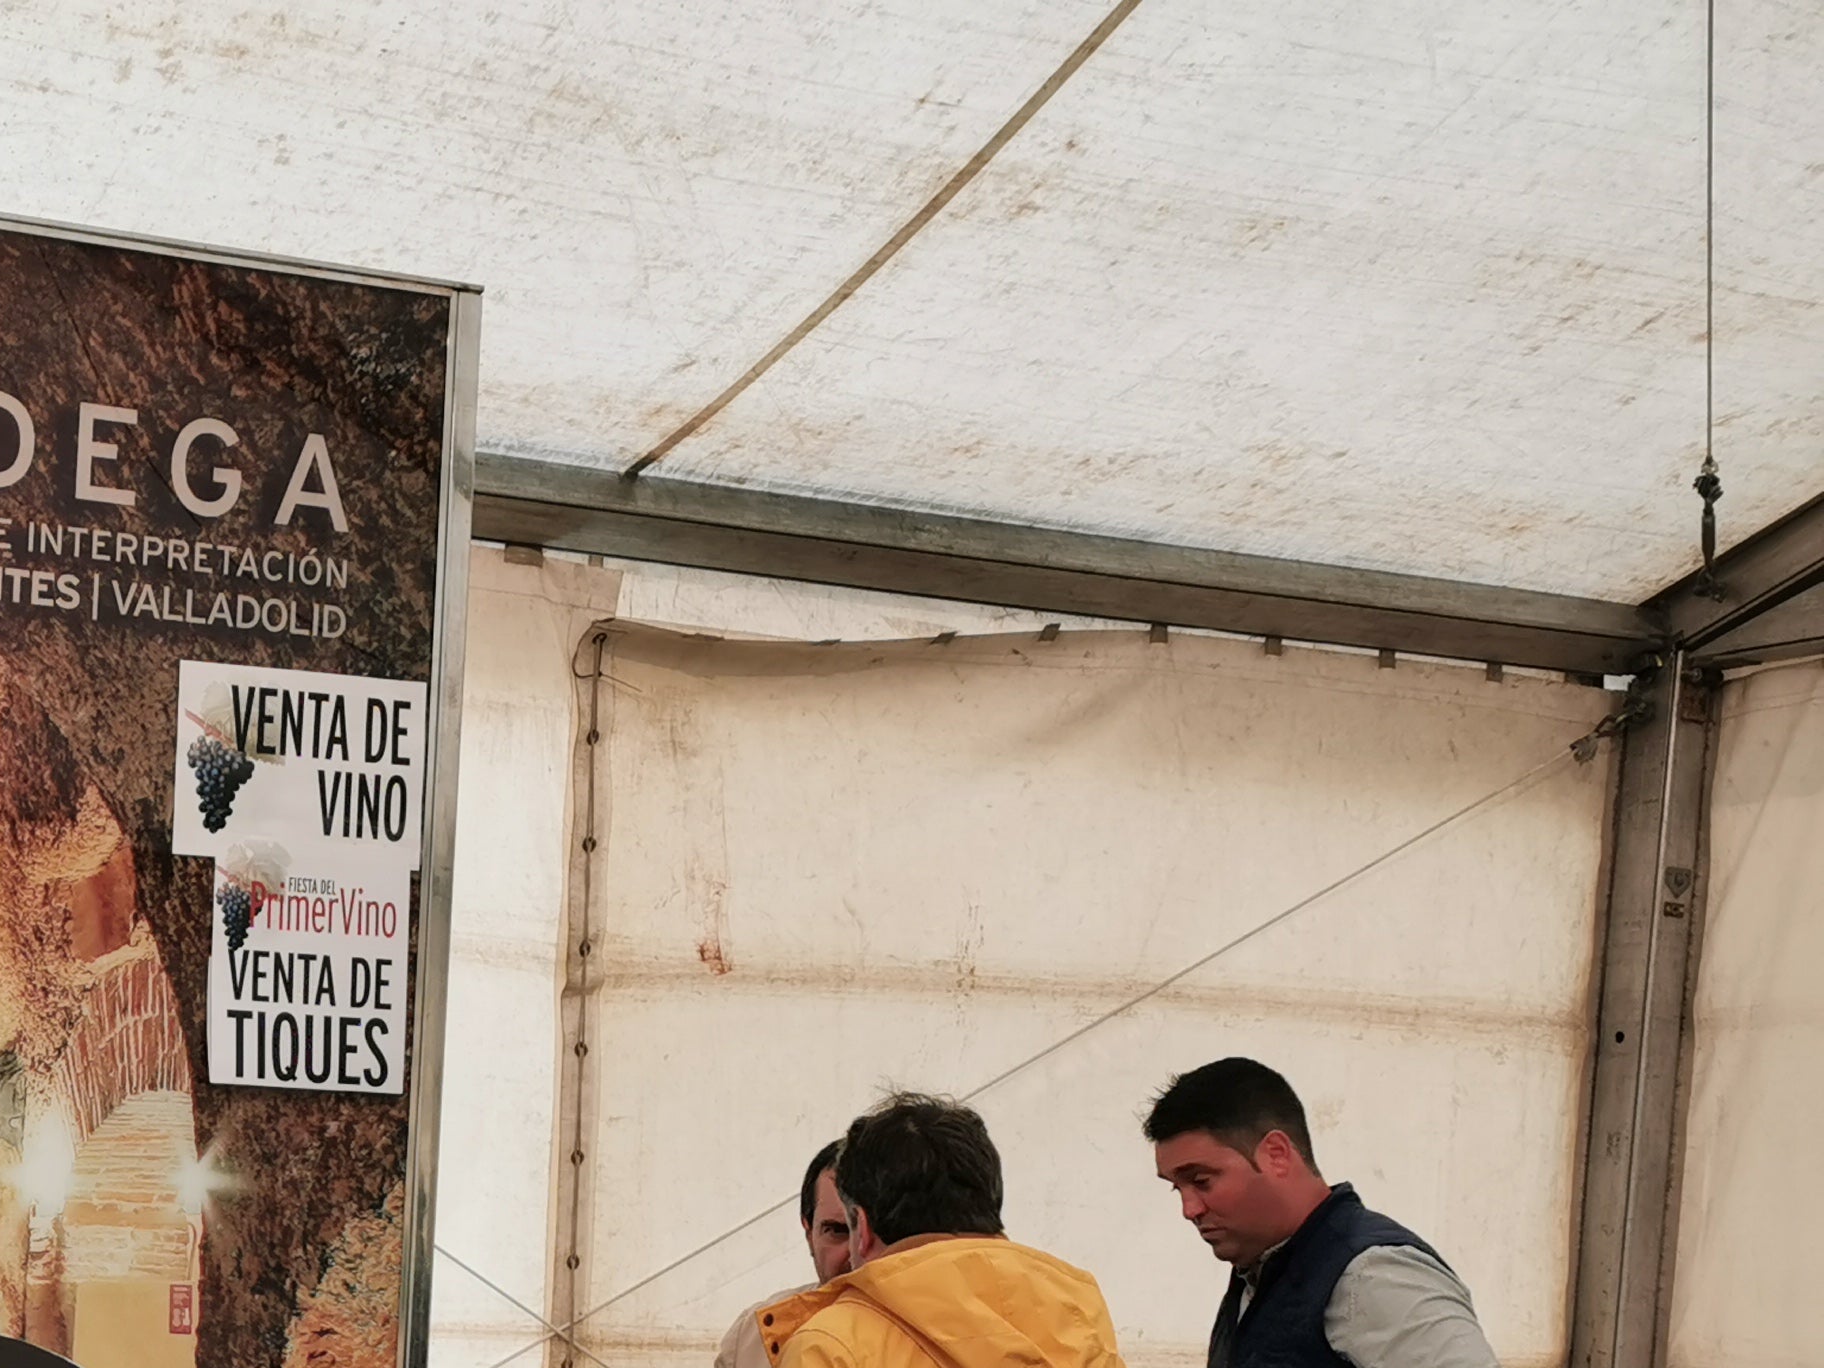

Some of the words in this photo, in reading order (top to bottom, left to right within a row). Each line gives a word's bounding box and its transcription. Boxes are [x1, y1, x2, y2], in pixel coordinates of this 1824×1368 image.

[27, 520, 349, 589] INTERPRETACIÓN
[111, 579, 348, 639] VALLADOLID
[231, 684, 350, 761] VENTA
[364, 697, 412, 766] DE
[318, 769, 407, 842] VINO
[288, 876, 317, 895] FIESTA
[320, 880, 336, 895] DEL
[227, 949, 336, 1007] VENTA
[350, 957, 392, 1010] DE
[226, 1009, 389, 1088] TIQUES
